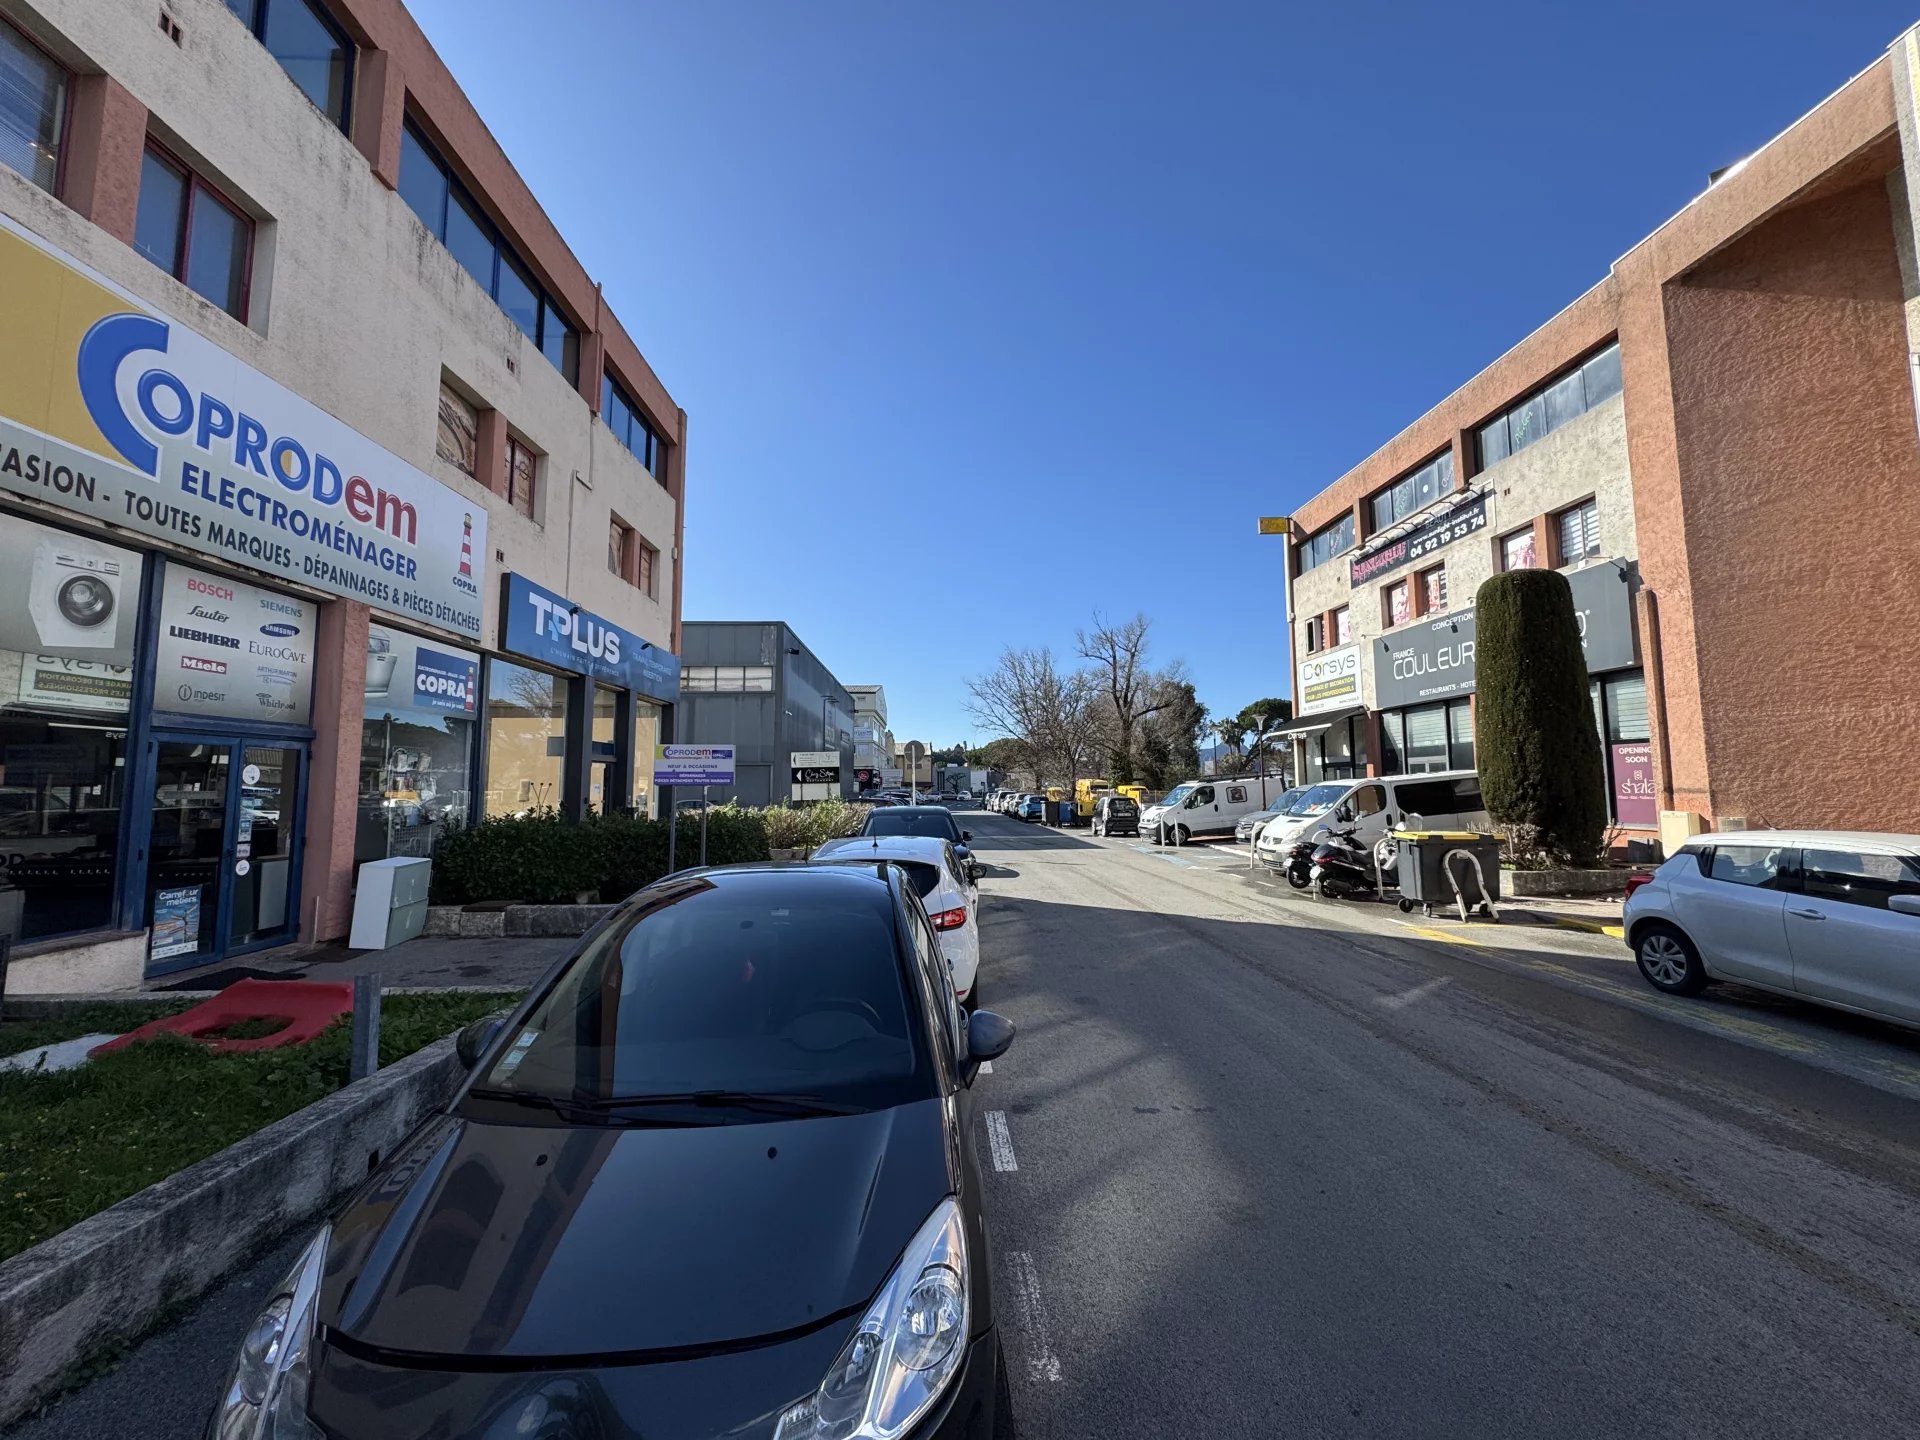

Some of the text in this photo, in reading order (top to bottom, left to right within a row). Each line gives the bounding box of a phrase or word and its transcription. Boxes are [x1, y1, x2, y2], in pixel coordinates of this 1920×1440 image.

[182, 462, 417, 580] ELECTROMÉNAGER
[0, 443, 96, 502] ASION
[124, 489, 201, 538] TOUTES
[207, 521, 290, 569] MARQUES
[304, 553, 389, 602] DÉPANNAGES
[392, 587, 400, 606] &
[403, 590, 433, 617] PIÈCES
[435, 602, 480, 633] DÉTACHÉES
[1410, 514, 1485, 558] 04 92 19 53 74
[187, 578, 233, 601] BOSCH
[452, 576, 477, 594] COPRA
[187, 605, 230, 623] Sauter
[260, 599, 302, 618] SIEMENS
[265, 624, 295, 636] SAMSUNG
[1432, 611, 1474, 631] CONCEPTION
[169, 625, 240, 650] LIEBHERR
[1392, 647, 1415, 661] FRANCE
[182, 656, 227, 673] Miele
[1303, 654, 1356, 681] Corsys
[416, 673, 465, 699] COPRA
[1419, 683, 1456, 697] RESTAURANTS
[1625, 755, 1648, 763] SOON
